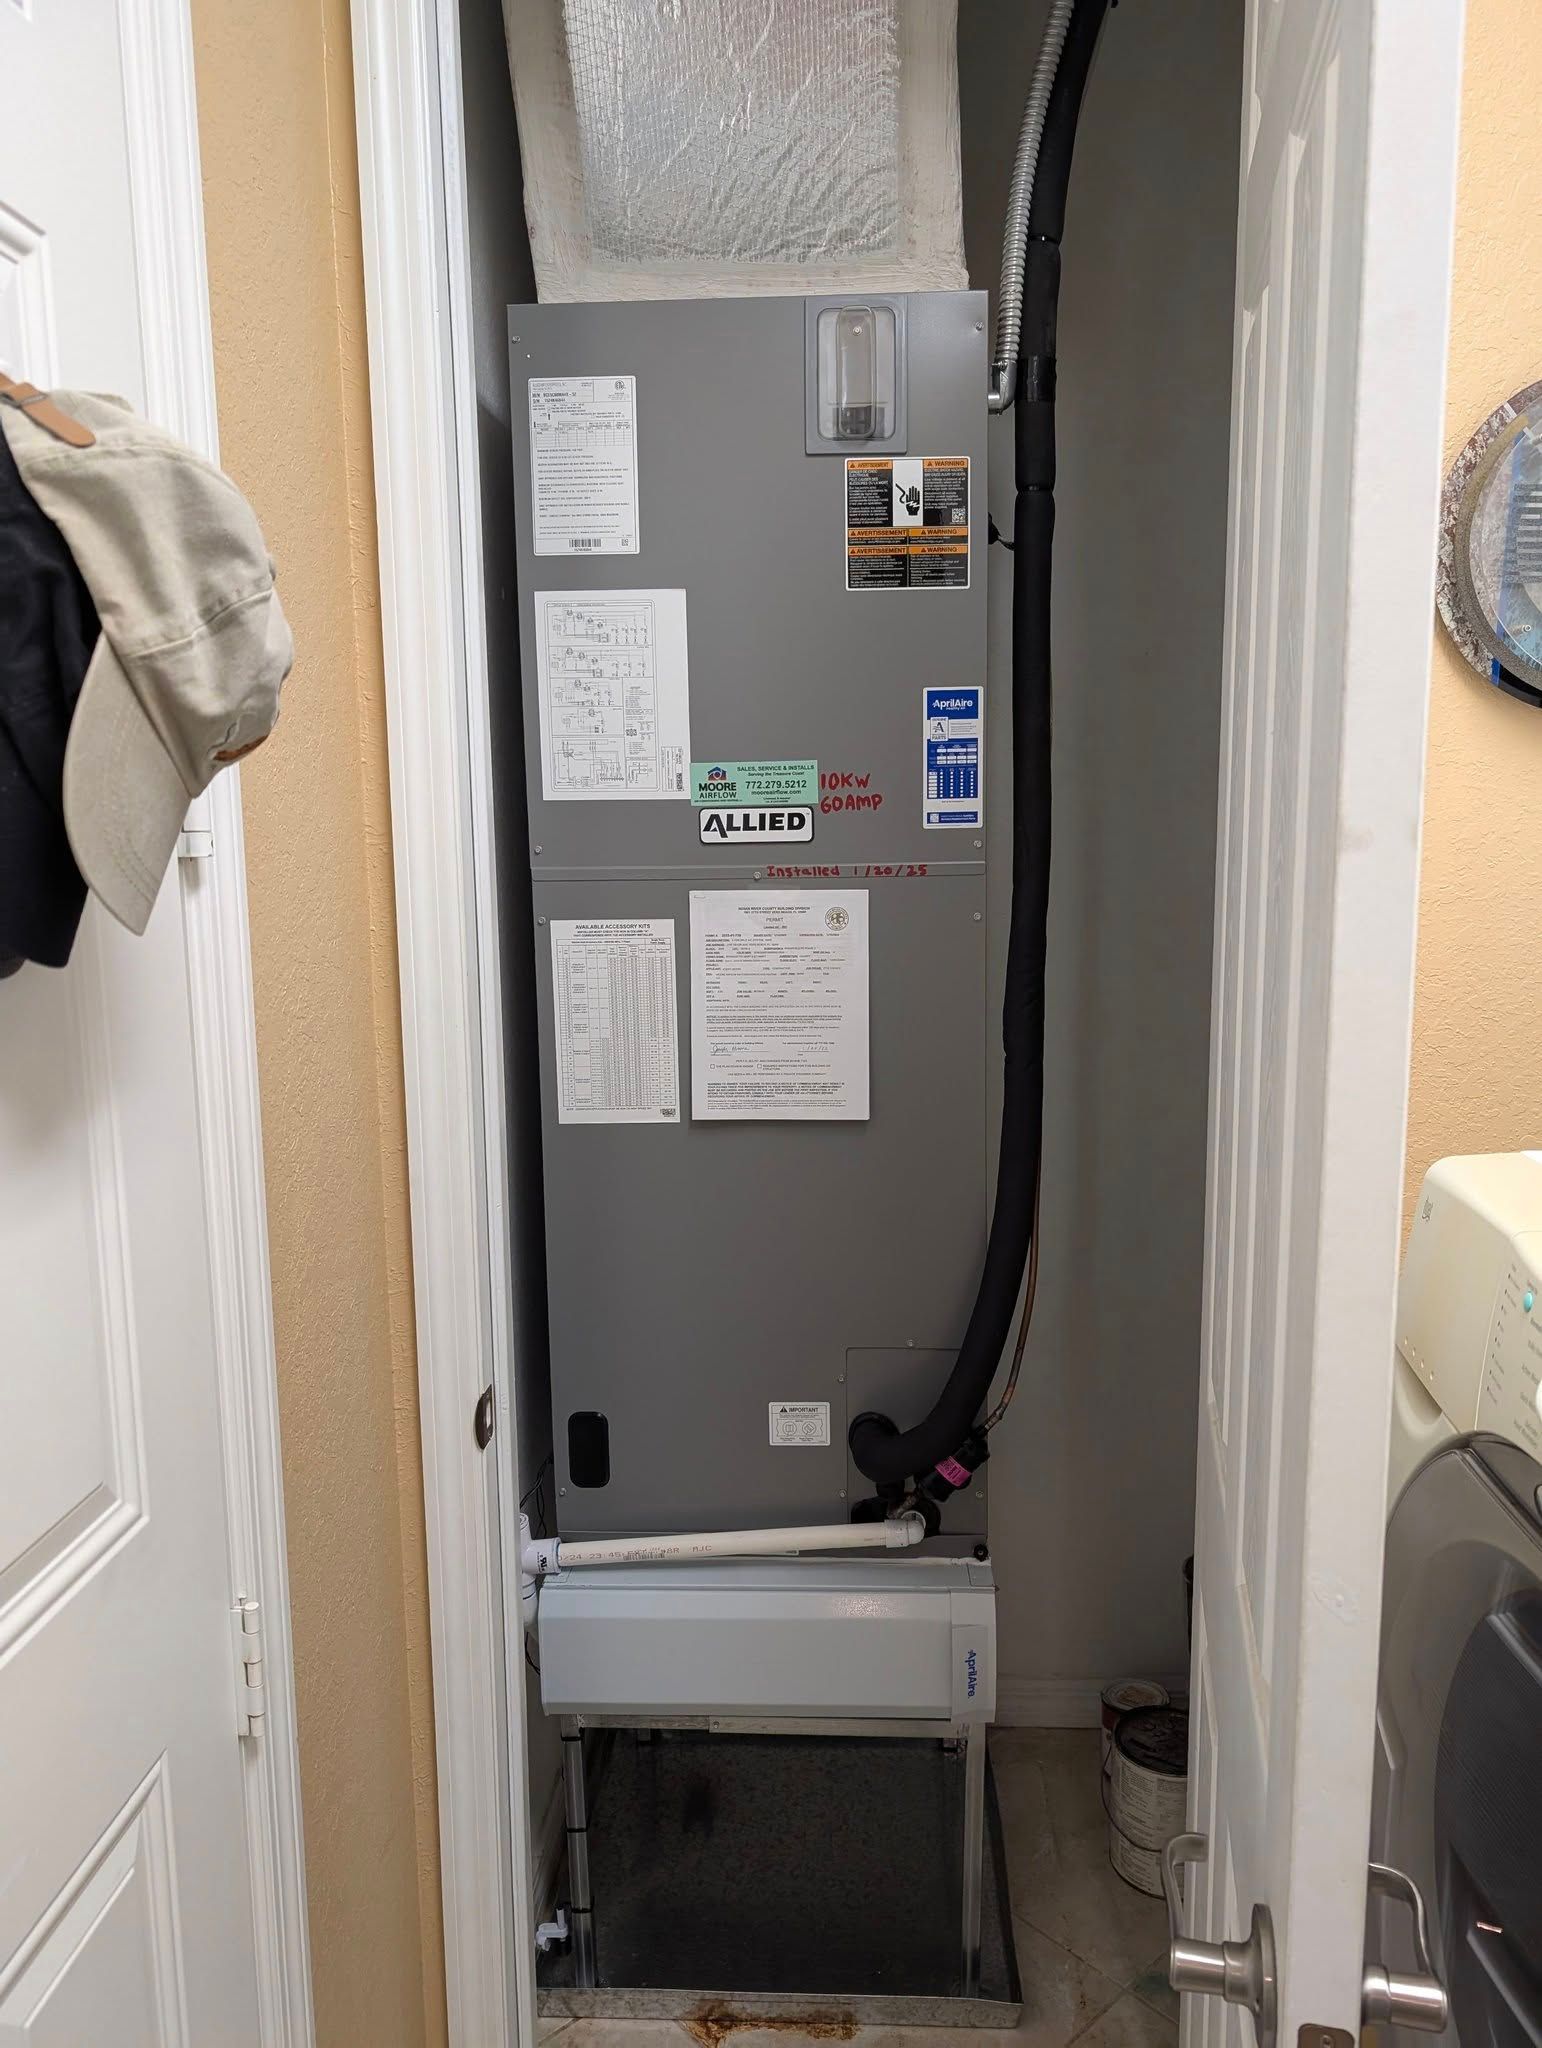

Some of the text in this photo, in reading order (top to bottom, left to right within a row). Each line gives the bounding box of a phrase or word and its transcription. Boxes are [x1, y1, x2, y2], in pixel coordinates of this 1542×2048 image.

[932, 699, 973, 710] AprilAire
[698, 782, 737, 791] MOORE
[745, 780, 807, 789] 772.279.5212
[703, 812, 806, 838] ALLIED
[766, 865, 840, 877] Installed
[965, 1649, 978, 1697] AprilAire
